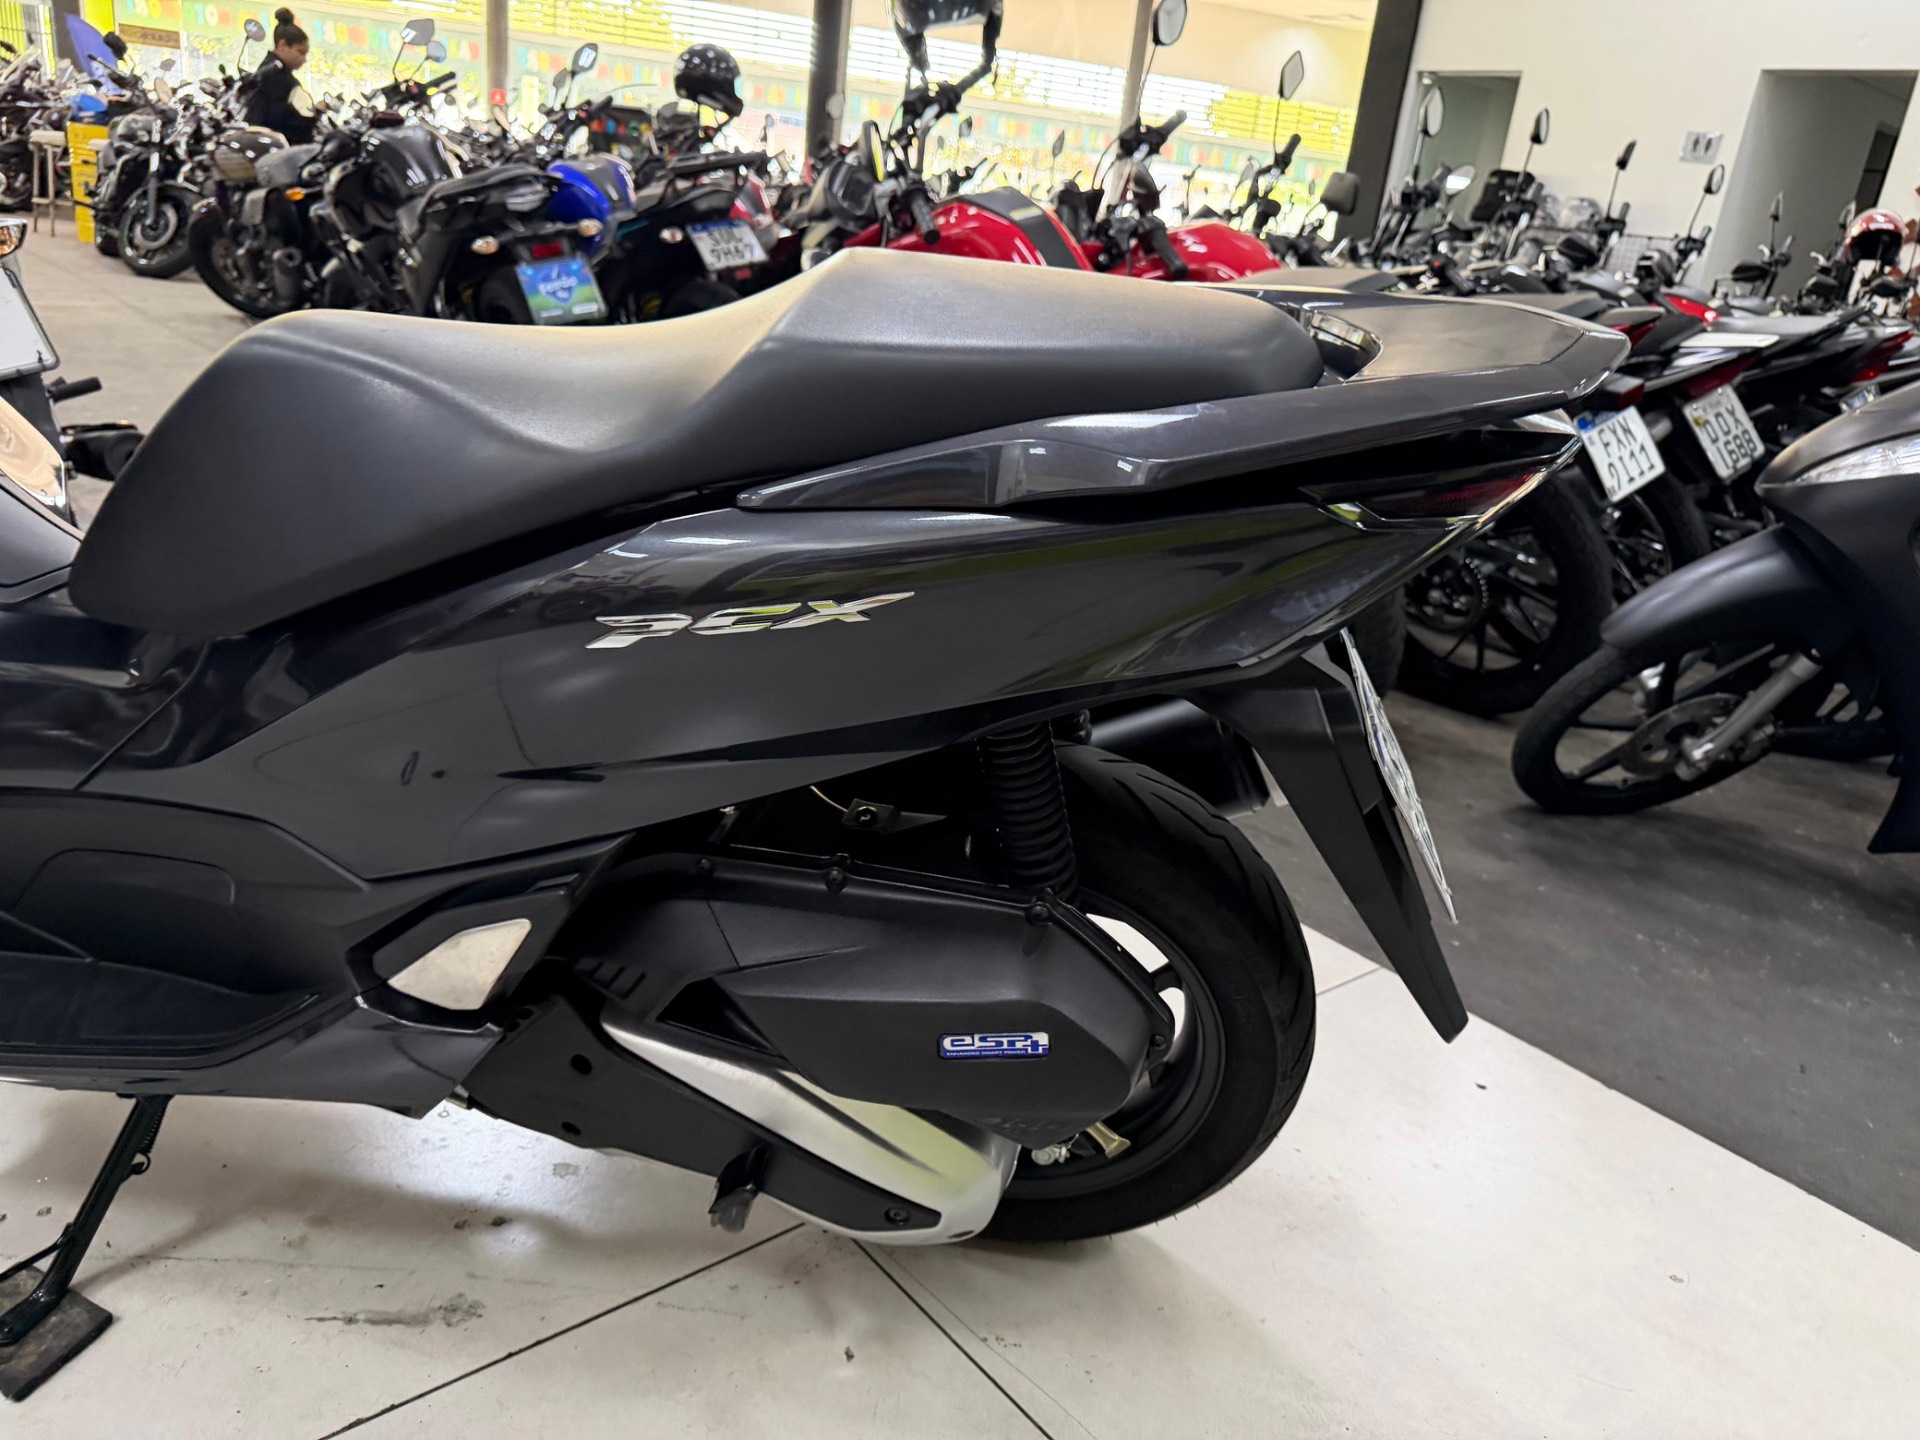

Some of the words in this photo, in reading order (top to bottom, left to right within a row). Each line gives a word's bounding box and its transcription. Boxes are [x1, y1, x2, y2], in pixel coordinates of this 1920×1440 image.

[1598, 415, 1638, 459] FXN
[1702, 403, 1744, 444] DOX
[585, 591, 915, 649] PCX
